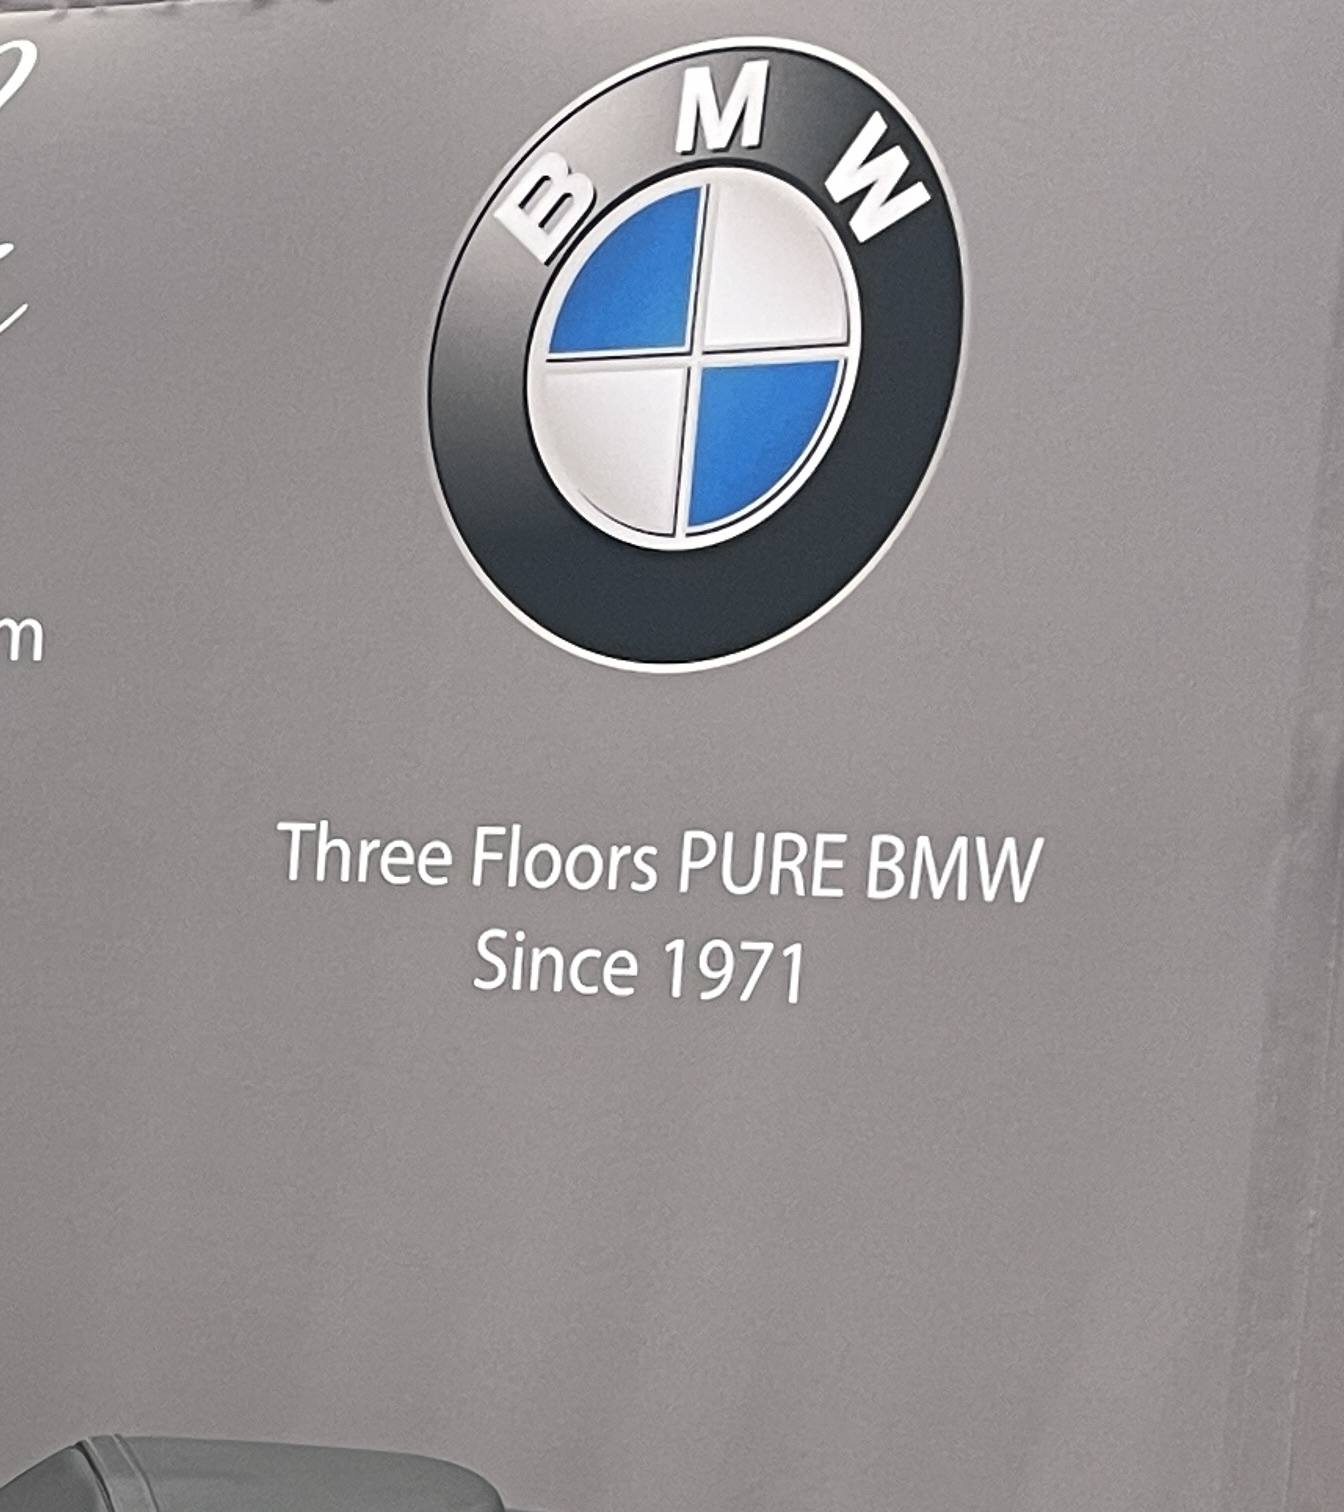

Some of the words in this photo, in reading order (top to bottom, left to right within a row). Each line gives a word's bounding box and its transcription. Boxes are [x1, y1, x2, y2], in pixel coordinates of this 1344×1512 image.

[494, 60, 931, 264] BMW
[276, 819, 453, 886] Three
[472, 823, 658, 892] Floors
[679, 830, 848, 898] PURE
[867, 833, 1045, 903] BMW
[473, 928, 638, 996] Since
[665, 938, 802, 1004] 1971
